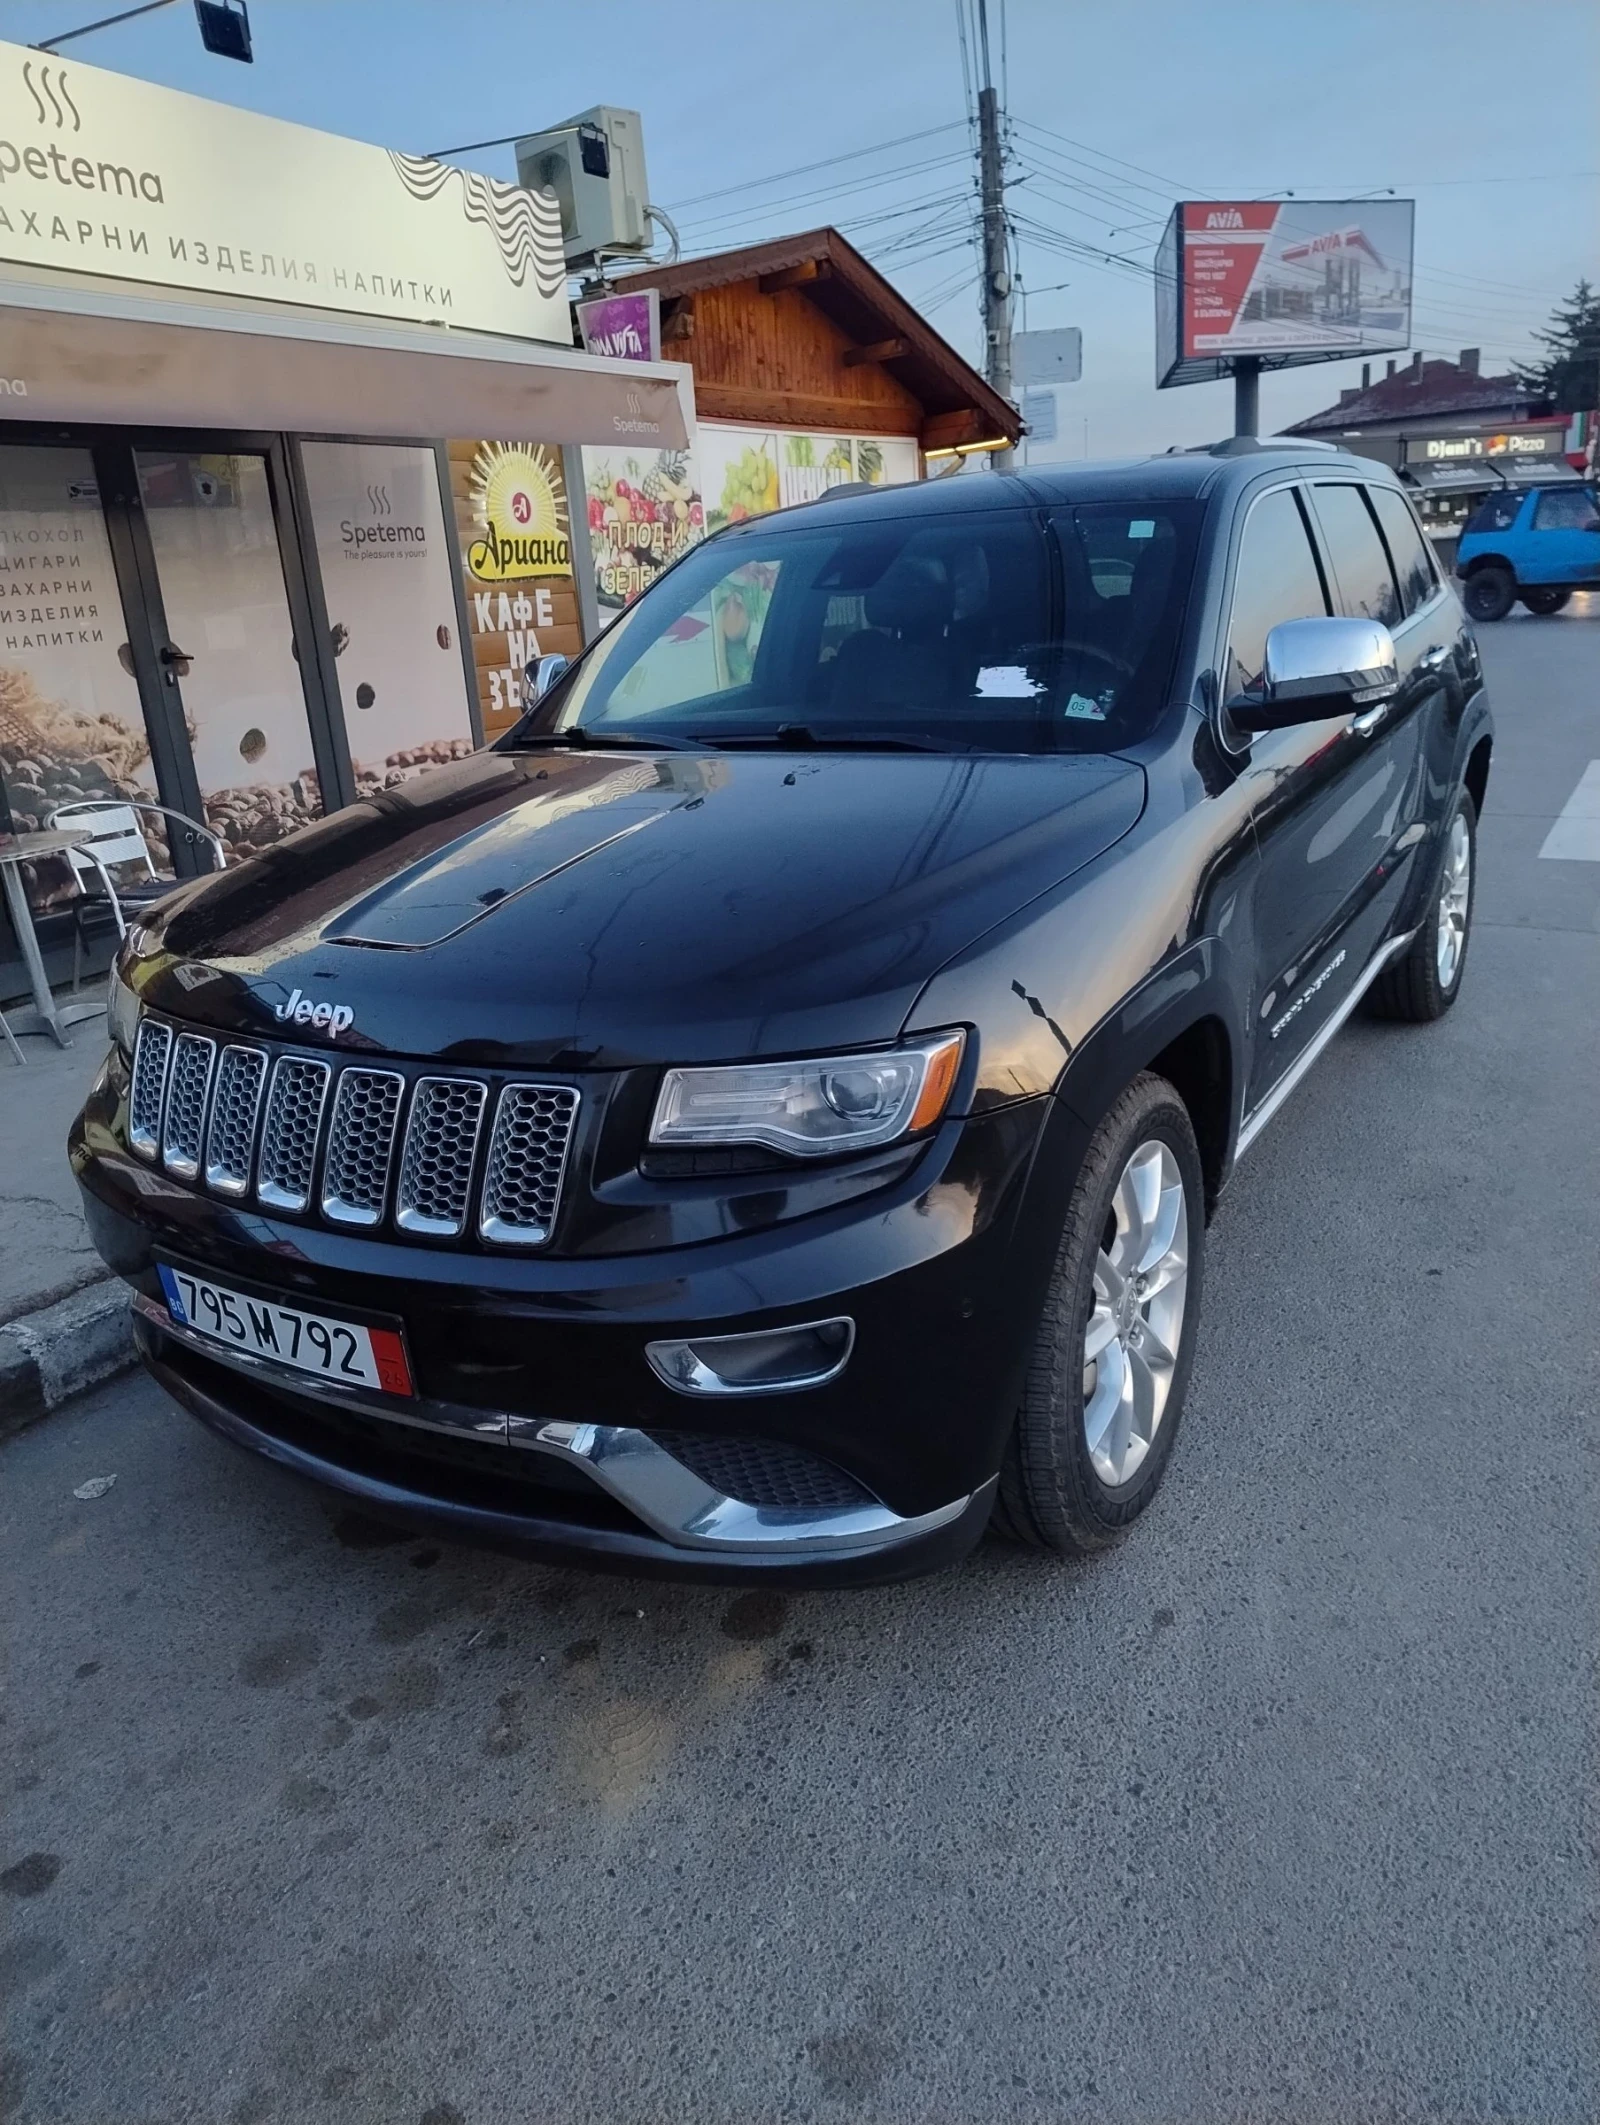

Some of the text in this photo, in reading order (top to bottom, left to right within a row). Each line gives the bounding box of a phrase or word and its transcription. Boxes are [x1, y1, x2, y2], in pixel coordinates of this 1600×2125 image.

[1206, 208, 1244, 228] AVIA
[168, 236, 317, 283] ИЗДЕЛИЯ
[333, 267, 453, 307] НАПИТКИ
[613, 416, 660, 434] Spetema
[1508, 436, 1545, 452] Pizza
[340, 520, 426, 549] Spetema
[344, 548, 428, 561] The pleasure is yours!
[474, 521, 571, 575] Ариана
[0, 554, 81, 572] ЦИГАРИ
[0, 604, 98, 623] ИЗДЕЛИЯ
[474, 588, 553, 633] КАФЕ
[6, 629, 104, 649] НАПИТКИ
[507, 629, 542, 670] НА
[1071, 701, 1085, 711] 05
[275, 989, 355, 1040] Jeep
